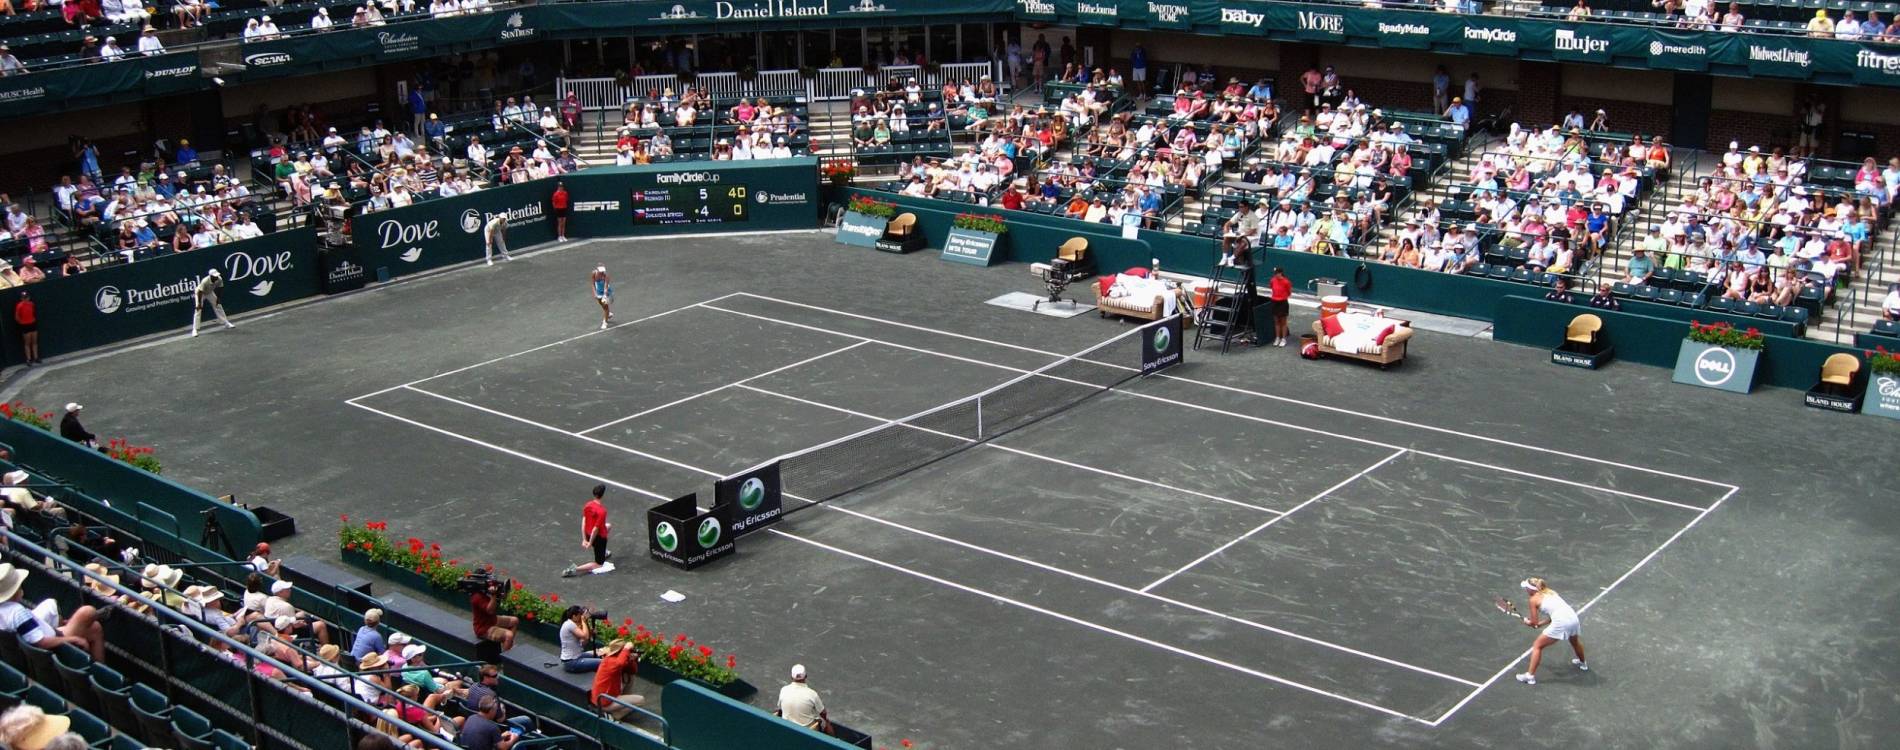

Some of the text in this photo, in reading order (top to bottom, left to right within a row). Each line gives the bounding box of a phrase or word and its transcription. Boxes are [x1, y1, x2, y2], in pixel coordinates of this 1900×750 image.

[716, 0, 829, 19] Daniel Island
[1158, 13, 1179, 22] HOME
[1221, 8, 1264, 27] baby
[1297, 11, 1344, 32] MORE
[1378, 23, 1430, 35] ReadyMade
[1556, 29, 1609, 54] mujer
[1664, 44, 1706, 55] meredith
[1750, 45, 1782, 62] Midwest
[1856, 50, 1900, 70] fitne
[154, 66, 197, 77] DUNLOP
[699, 188, 708, 200] 5
[728, 187, 745, 198] 40
[770, 193, 806, 201] Prudential
[485, 202, 543, 223] Prdential
[574, 201, 619, 211] ESPN2
[700, 205, 709, 217] 4
[734, 204, 742, 215] 0
[378, 220, 438, 249] Dove
[225, 251, 291, 281] Dove
[127, 276, 201, 304] Prudential
[1143, 352, 1179, 370] Sony Ericsson
[1553, 353, 1573, 363] ISLAND
[1700, 359, 1729, 373] DELL
[1806, 395, 1830, 406] ISLAND
[1831, 400, 1853, 410] HOUSE
[746, 508, 781, 526] Ericsson
[664, 553, 684, 564] Ericsson
[688, 542, 734, 564] Sony Ericsson
